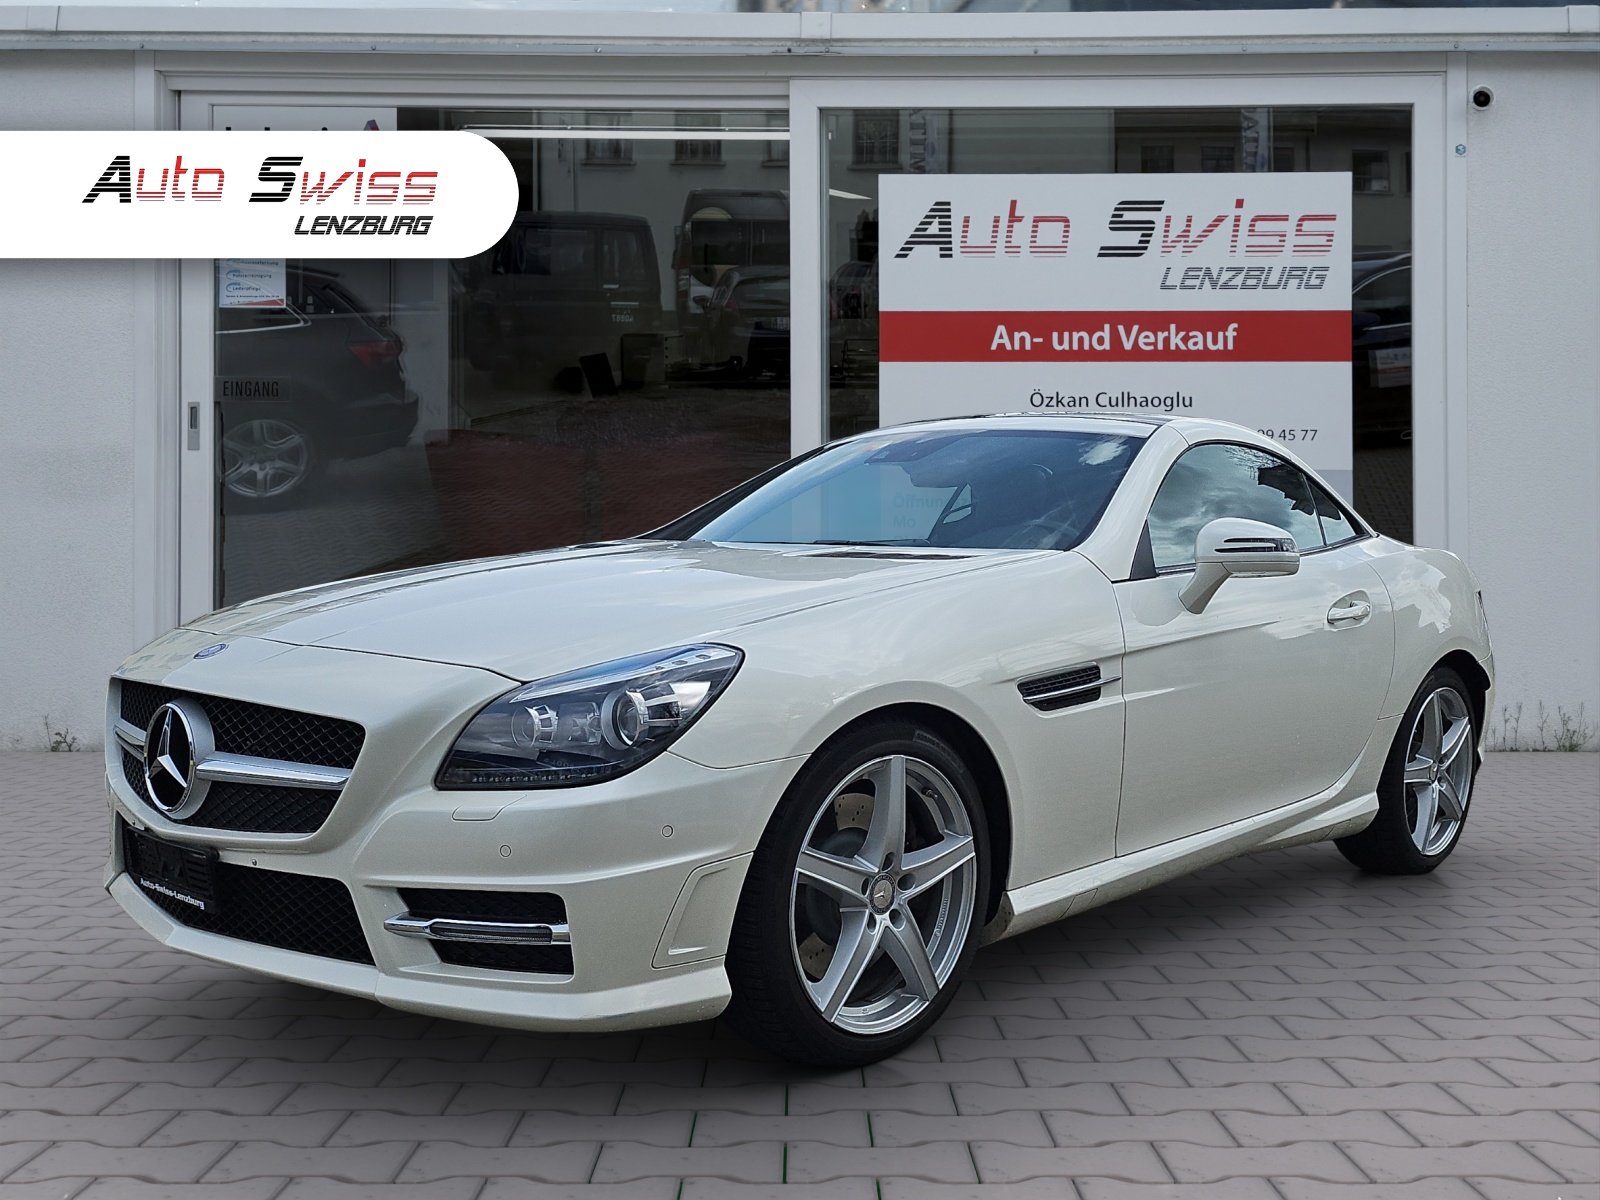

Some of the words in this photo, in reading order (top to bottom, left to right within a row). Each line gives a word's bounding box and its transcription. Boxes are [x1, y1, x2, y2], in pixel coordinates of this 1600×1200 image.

[894, 199, 1070, 258] Auto
[1097, 198, 1337, 257] Swiss
[1160, 266, 1330, 290] LENZBURG
[990, 324, 1043, 351] An-
[1052, 323, 1110, 351] und
[1117, 323, 1238, 351] Verkauf
[223, 380, 279, 397] EINGANG
[1029, 388, 1089, 408] Özkan
[1095, 391, 1193, 412] Culhaoglu
[1278, 428, 1296, 441] 45
[1300, 428, 1318, 441] 77
